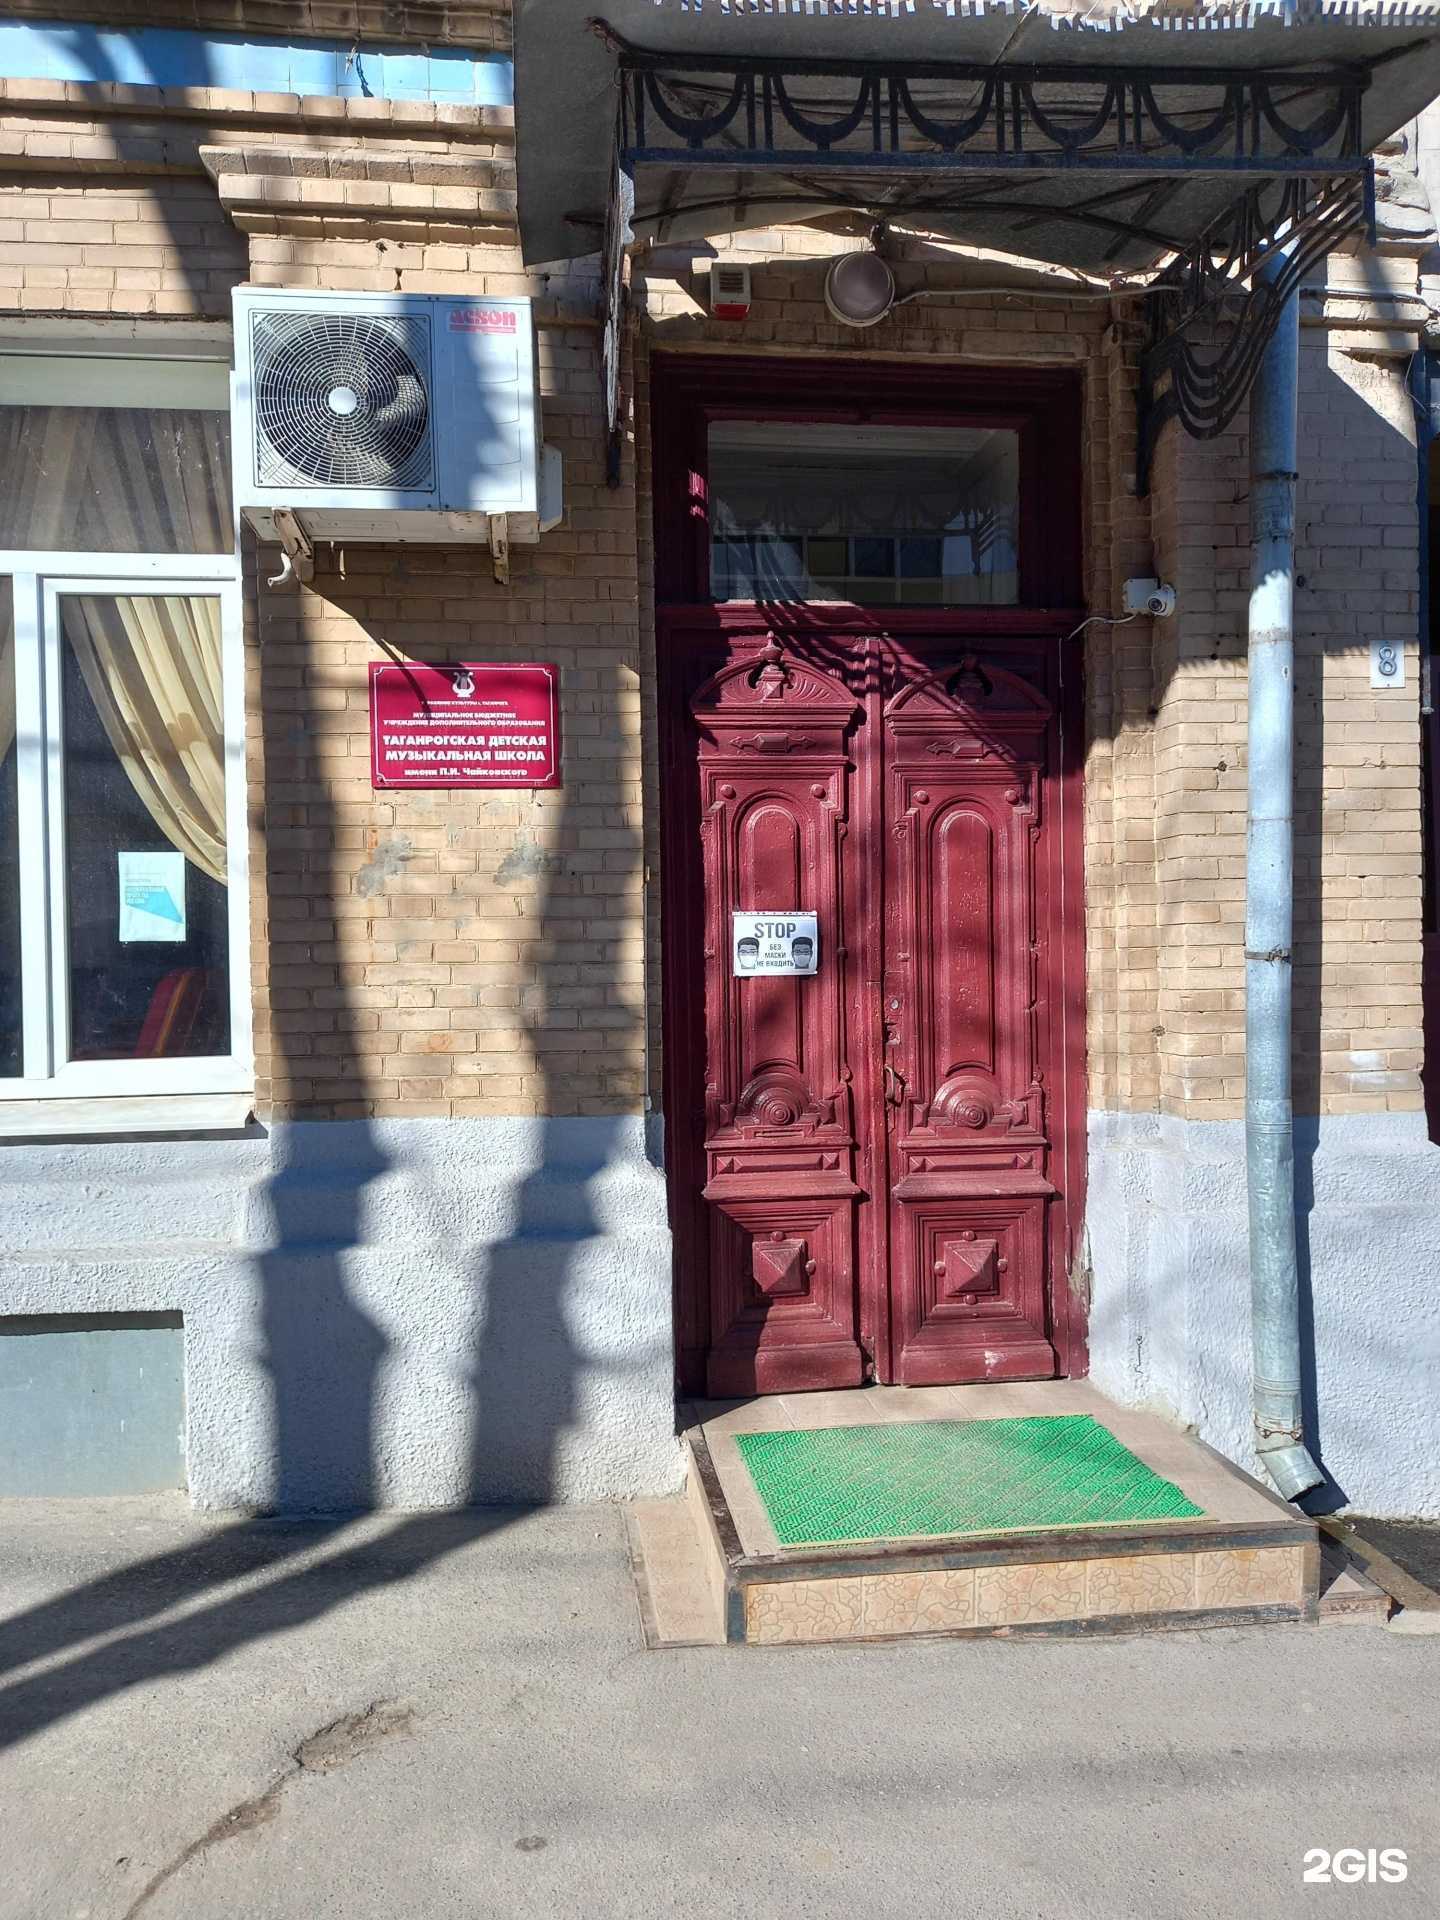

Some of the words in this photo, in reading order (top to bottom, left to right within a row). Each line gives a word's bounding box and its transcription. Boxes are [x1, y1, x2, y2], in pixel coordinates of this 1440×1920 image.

[1379, 645, 1397, 676] 8
[383, 735, 485, 746] ТАГАНРОГСКАЯ
[488, 735, 547, 748] ДЕТСКАЯ
[385, 750, 491, 761] МУЗЫКАЛЬНАЯ
[494, 750, 546, 761] ШКОЛА
[404, 769, 437, 777] имени
[439, 767, 461, 776] П.И.
[462, 767, 528, 777] Чайковского
[754, 922, 796, 938] STOP
[769, 943, 782, 951] БЕЗ
[765, 960, 794, 968] ВХОДИТЬ
